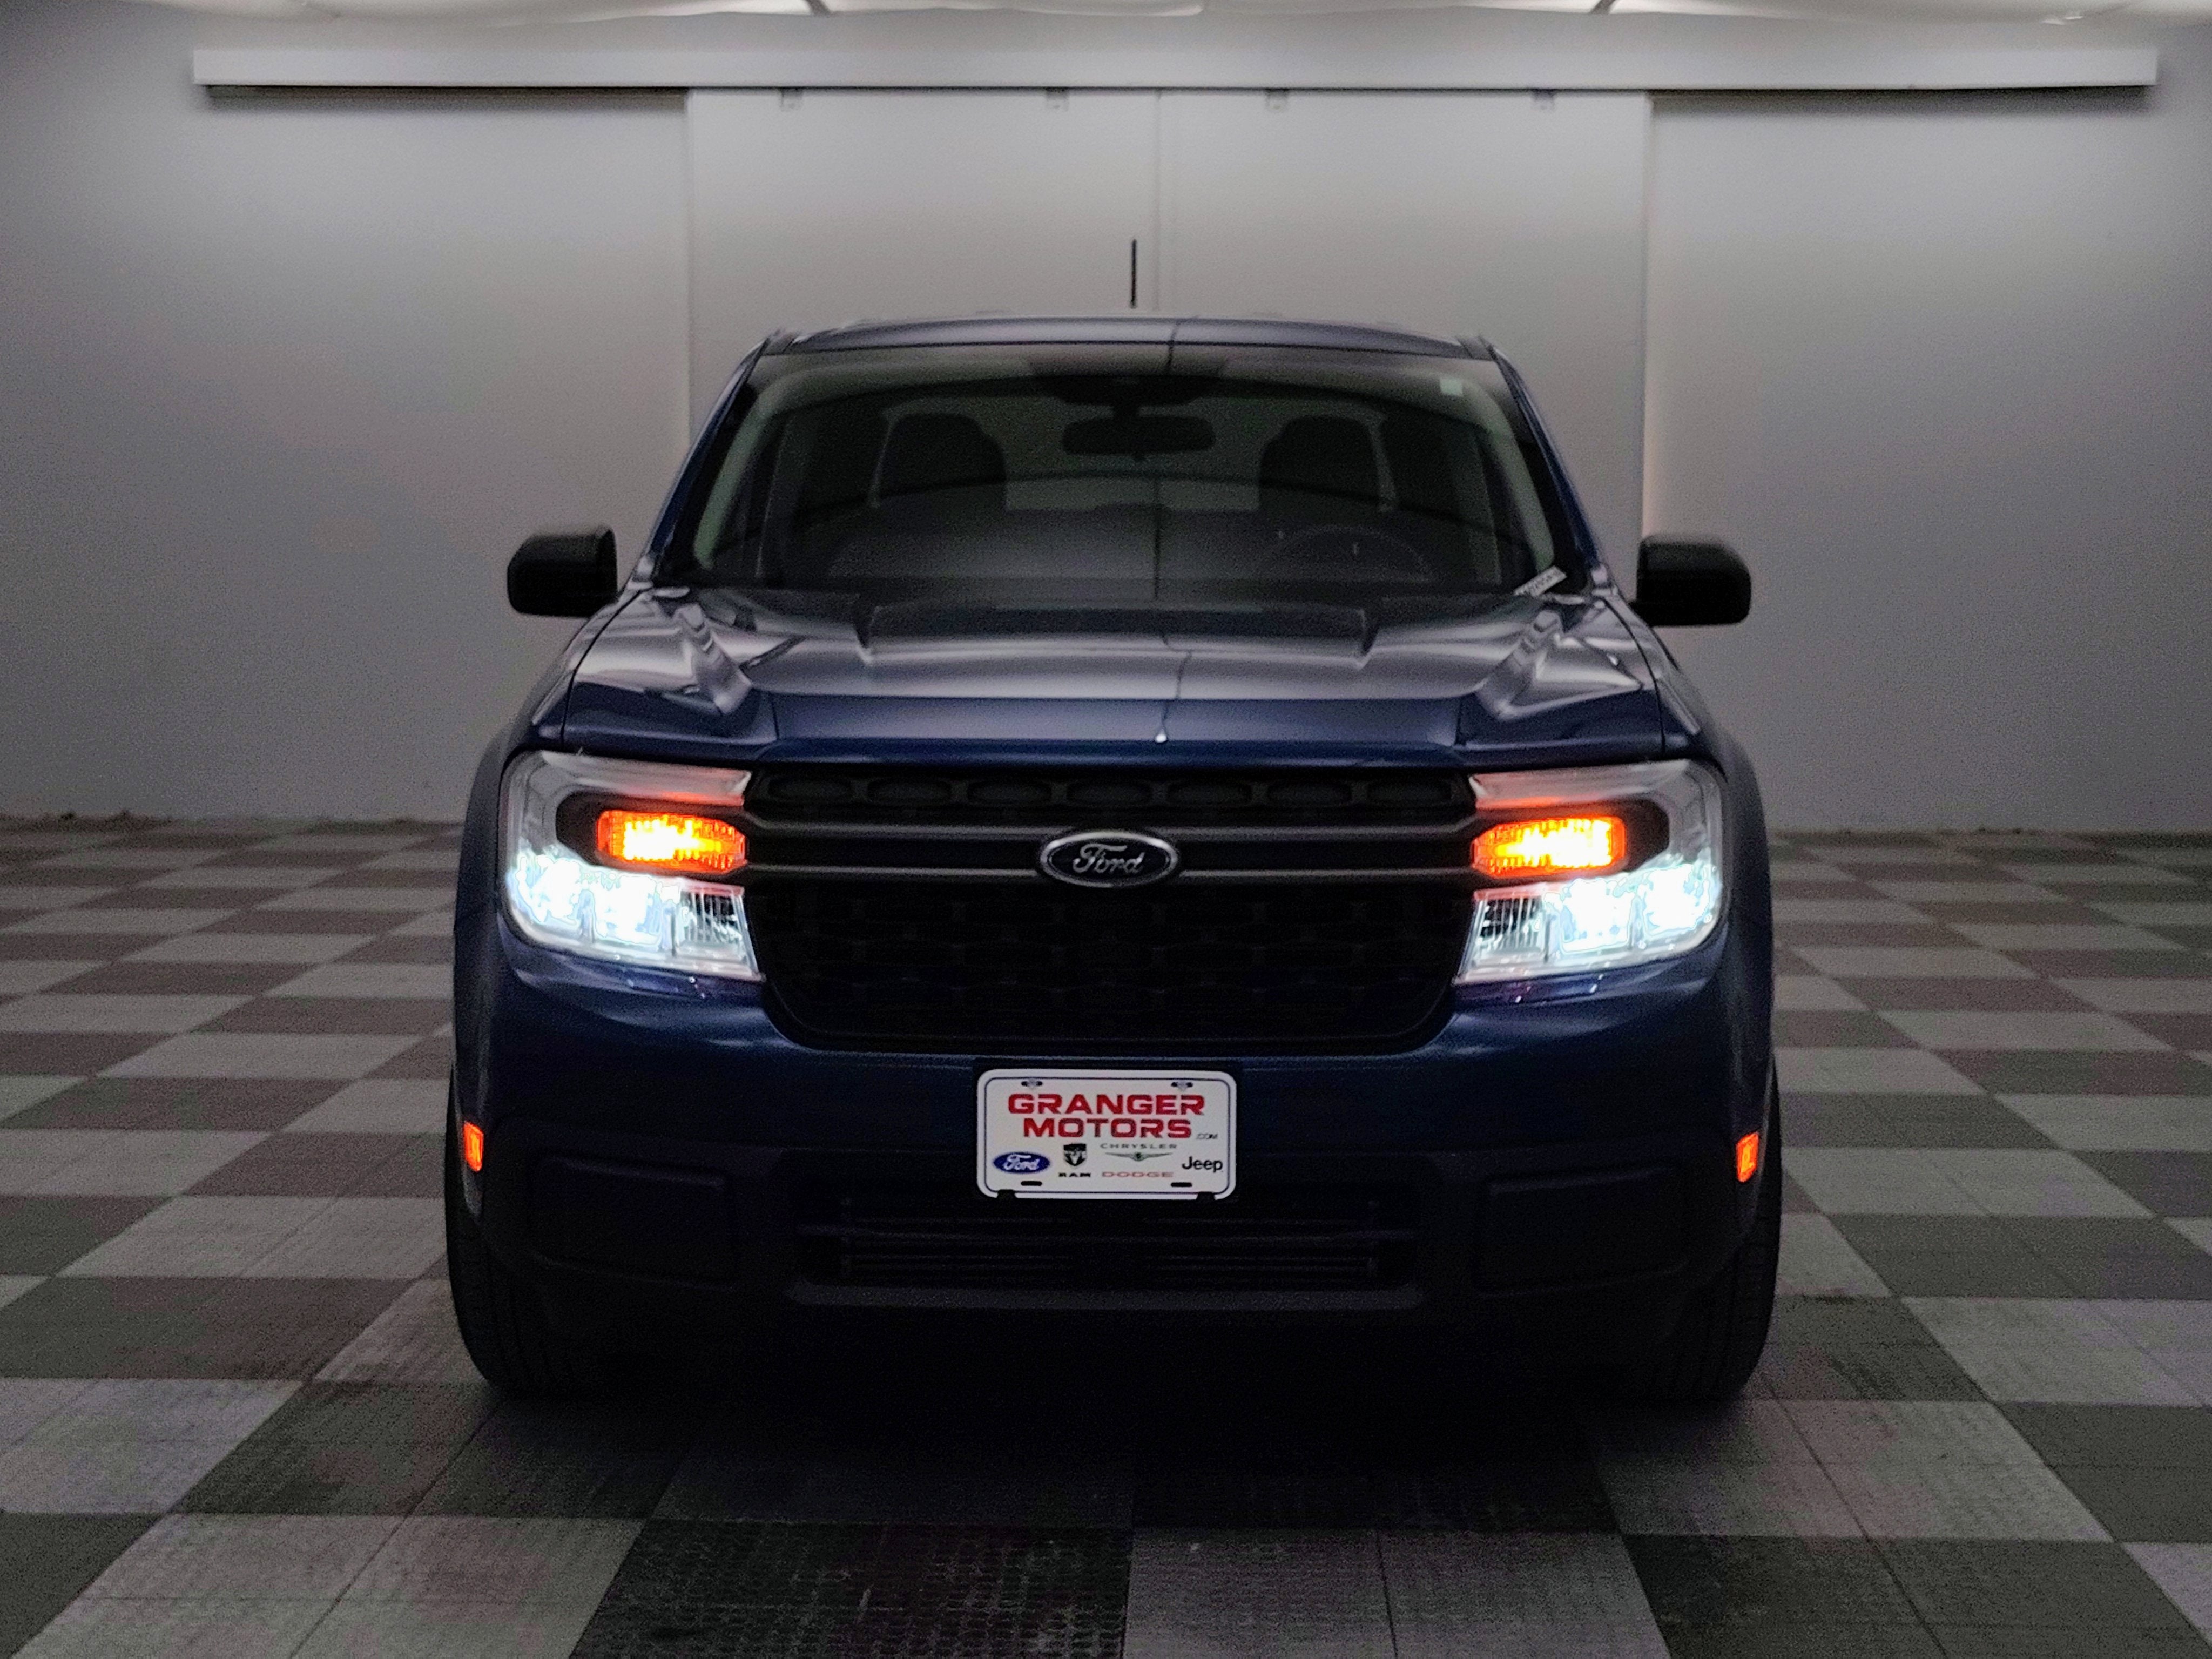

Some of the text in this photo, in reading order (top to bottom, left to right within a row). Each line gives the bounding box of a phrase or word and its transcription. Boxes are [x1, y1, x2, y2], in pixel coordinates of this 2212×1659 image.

[1073, 843, 1145, 873] Ford
[1008, 1094, 1205, 1115] GRANGER
[1023, 1118, 1192, 1138] MOTORS
[1003, 1154, 1040, 1170] Ford
[1182, 1156, 1223, 1173] Jeep
